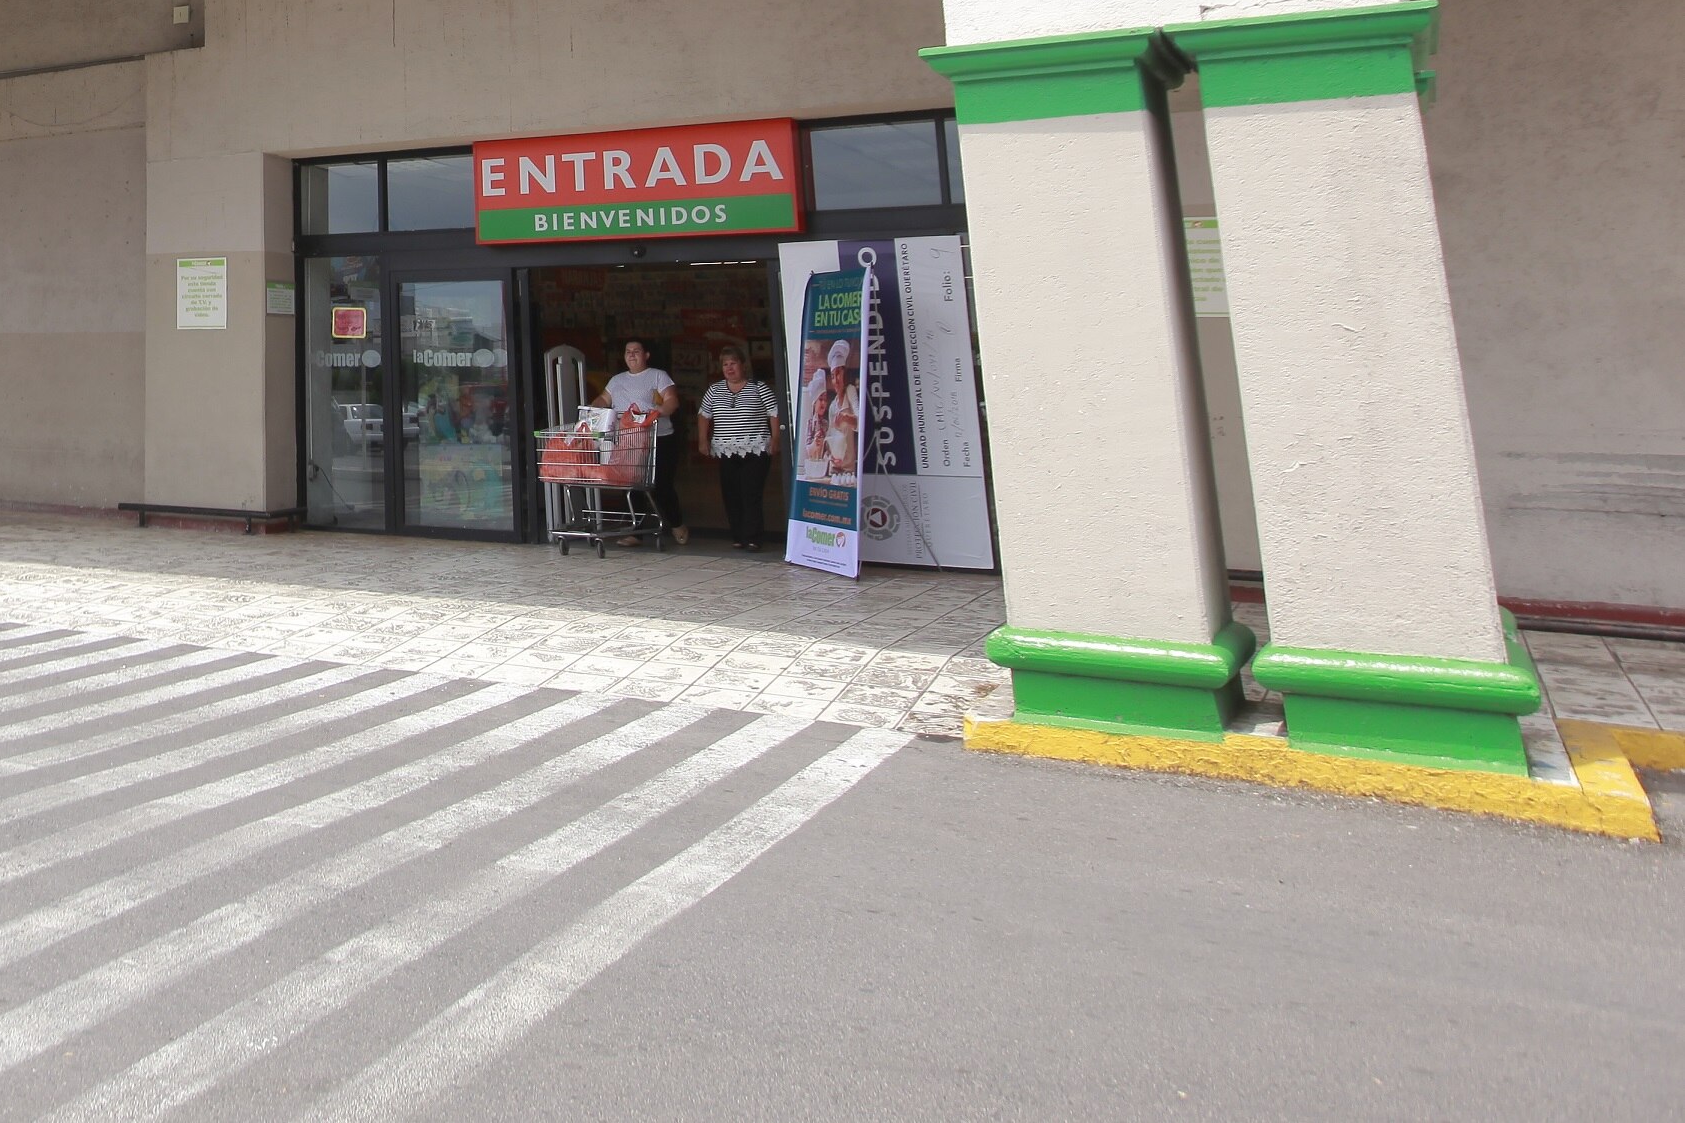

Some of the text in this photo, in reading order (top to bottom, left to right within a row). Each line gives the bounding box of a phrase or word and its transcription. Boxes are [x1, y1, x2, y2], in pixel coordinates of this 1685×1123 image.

[480, 139, 784, 197] ENTRADA
[533, 204, 728, 232] BIENVENIDOS
[942, 271, 954, 302] Folio:
[818, 294, 830, 310] LA
[906, 296, 915, 316] CIVIL
[815, 308, 861, 327] EN TU CAS
[412, 349, 473, 367] laComer
[908, 318, 920, 371] PROTECCIÓN
[914, 374, 922, 385] DE
[916, 388, 926, 433] MUNICIPAL
[920, 436, 929, 468] UNIDAD
[942, 439, 951, 467] Orden
[961, 441, 971, 468] Fecha
